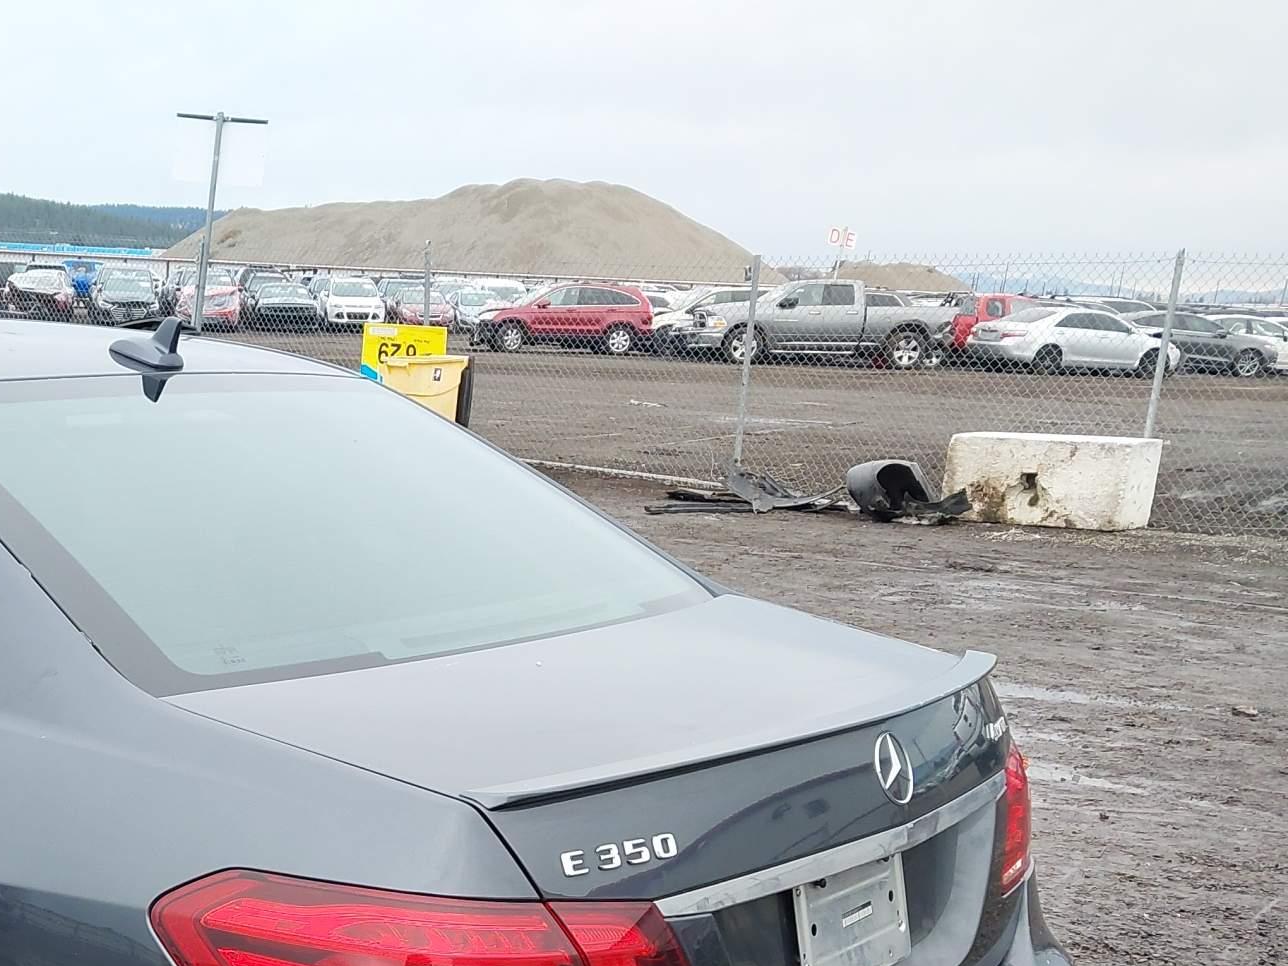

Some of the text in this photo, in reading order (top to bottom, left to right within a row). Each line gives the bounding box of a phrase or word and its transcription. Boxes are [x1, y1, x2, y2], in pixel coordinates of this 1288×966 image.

[830, 228, 856, 247] D E
[560, 832, 678, 877] E 350
